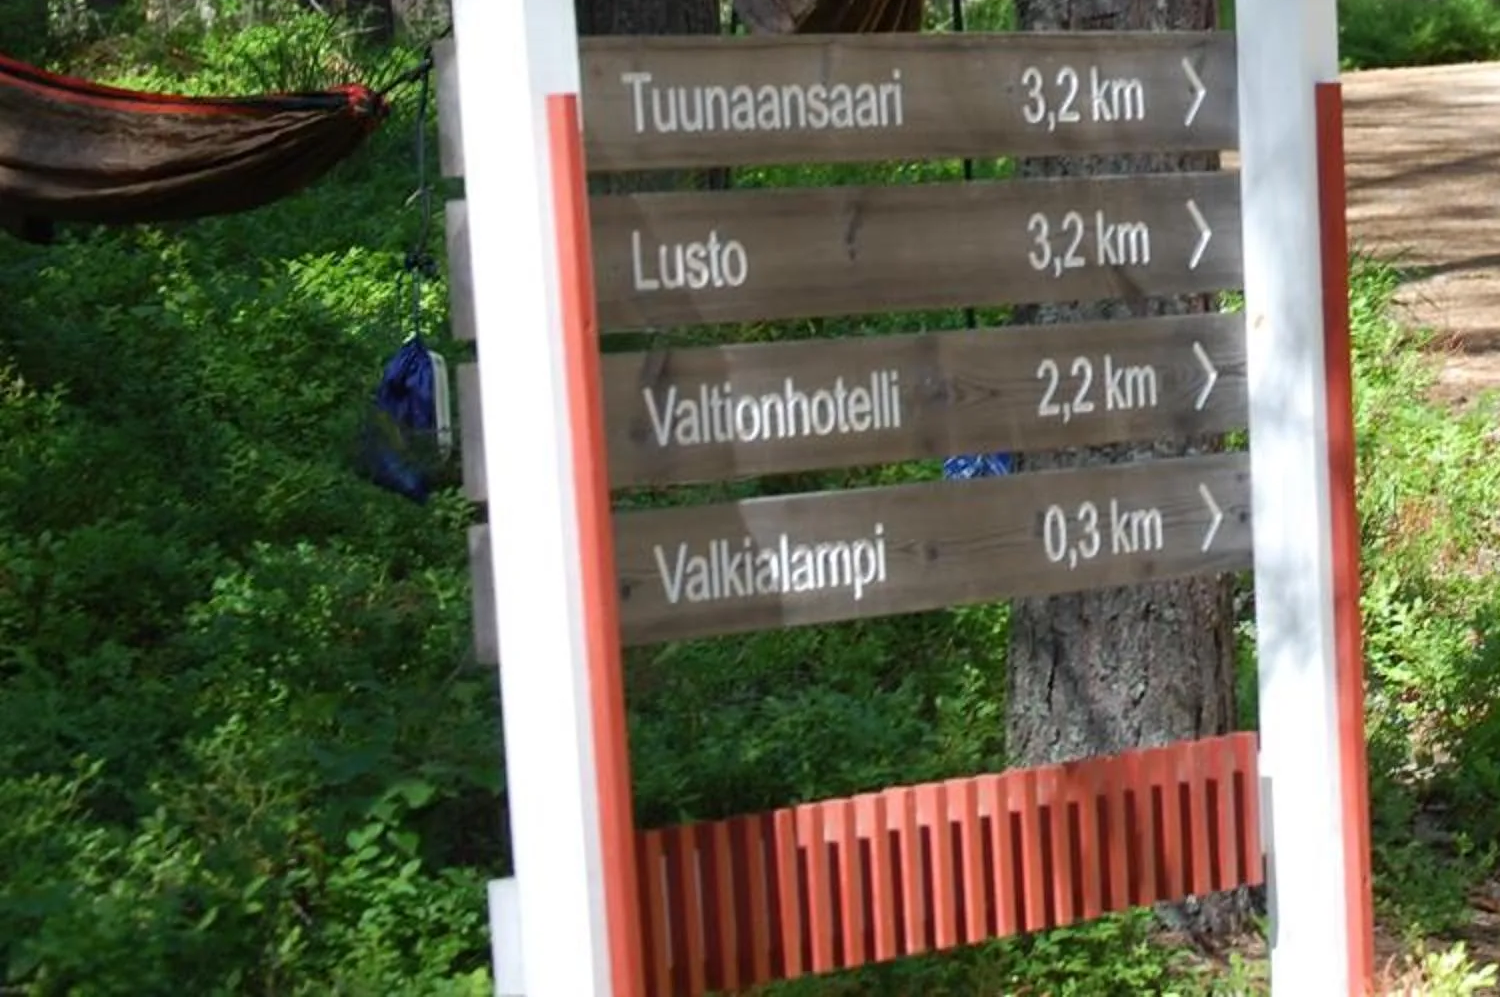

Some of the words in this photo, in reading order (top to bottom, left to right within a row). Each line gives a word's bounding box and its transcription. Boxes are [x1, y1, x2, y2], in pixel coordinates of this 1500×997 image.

[620, 69, 904, 135] Tuunaansaari
[1022, 65, 1080, 133] 3,2
[1091, 64, 1145, 121] km
[631, 229, 749, 291] Lusto
[1026, 210, 1085, 278] 3,2
[1096, 209, 1151, 265] km
[643, 369, 901, 446] Valtionhotelli
[1036, 356, 1095, 424] 2,2
[1104, 354, 1158, 411] km
[653, 522, 887, 603] Valkialampi
[1043, 501, 1101, 570] 0,3
[1110, 498, 1164, 553] km
